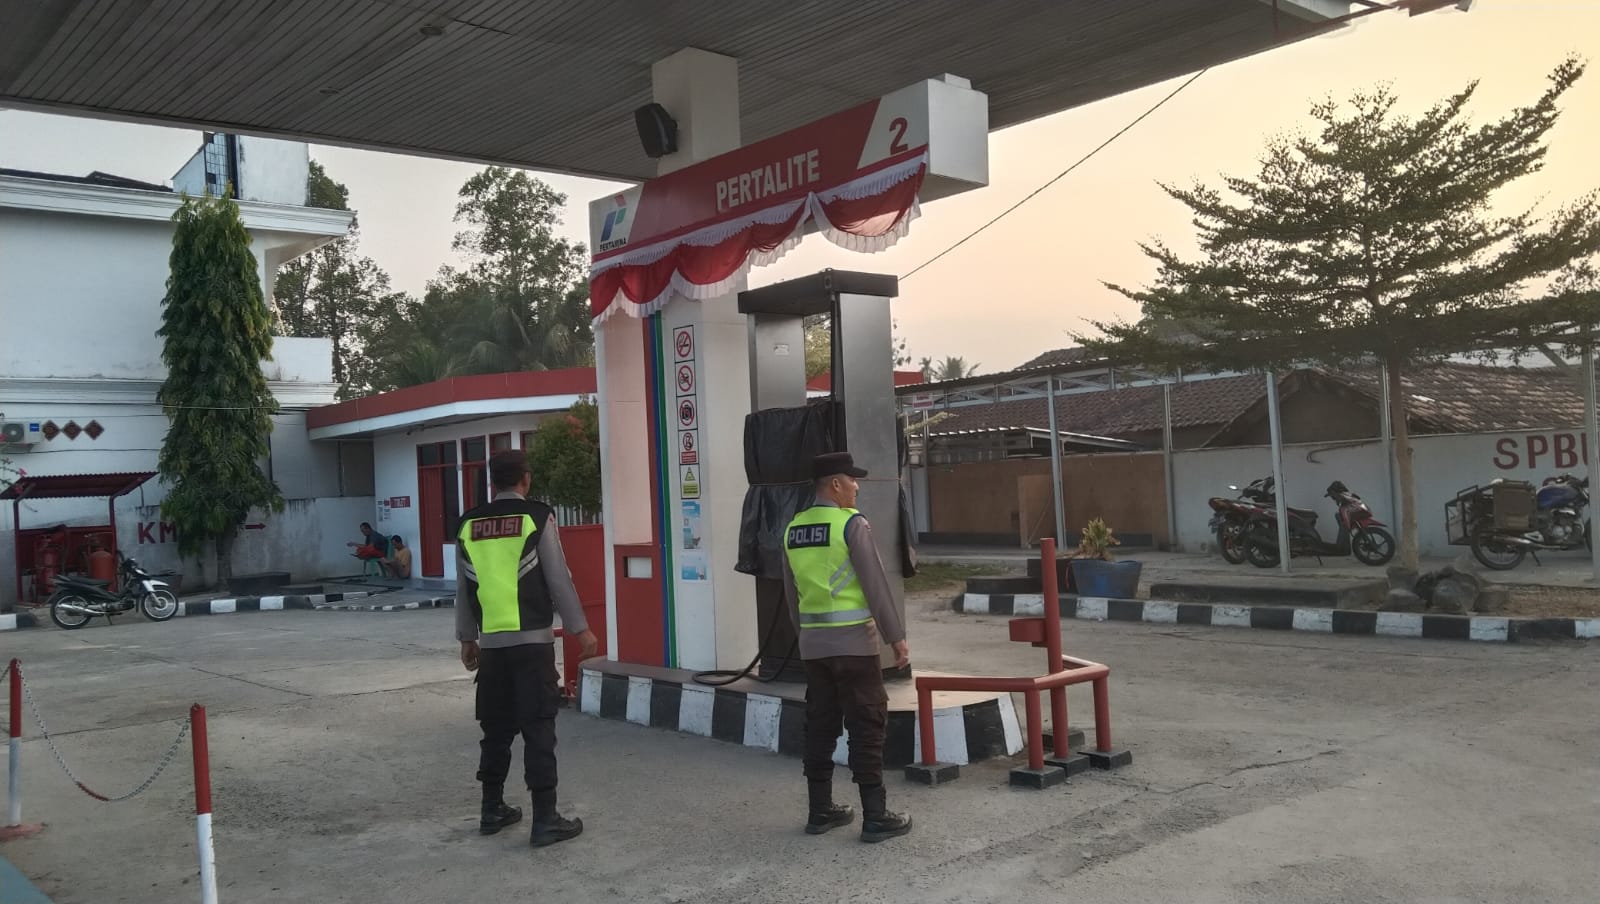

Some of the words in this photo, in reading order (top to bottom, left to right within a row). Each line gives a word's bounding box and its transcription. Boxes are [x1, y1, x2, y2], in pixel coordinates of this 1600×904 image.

[889, 117, 908, 155] 2
[716, 149, 819, 212] PERTALITE
[599, 237, 627, 252] PERTAMINA
[473, 517, 520, 538] POLISI
[789, 527, 827, 544] POLISI
